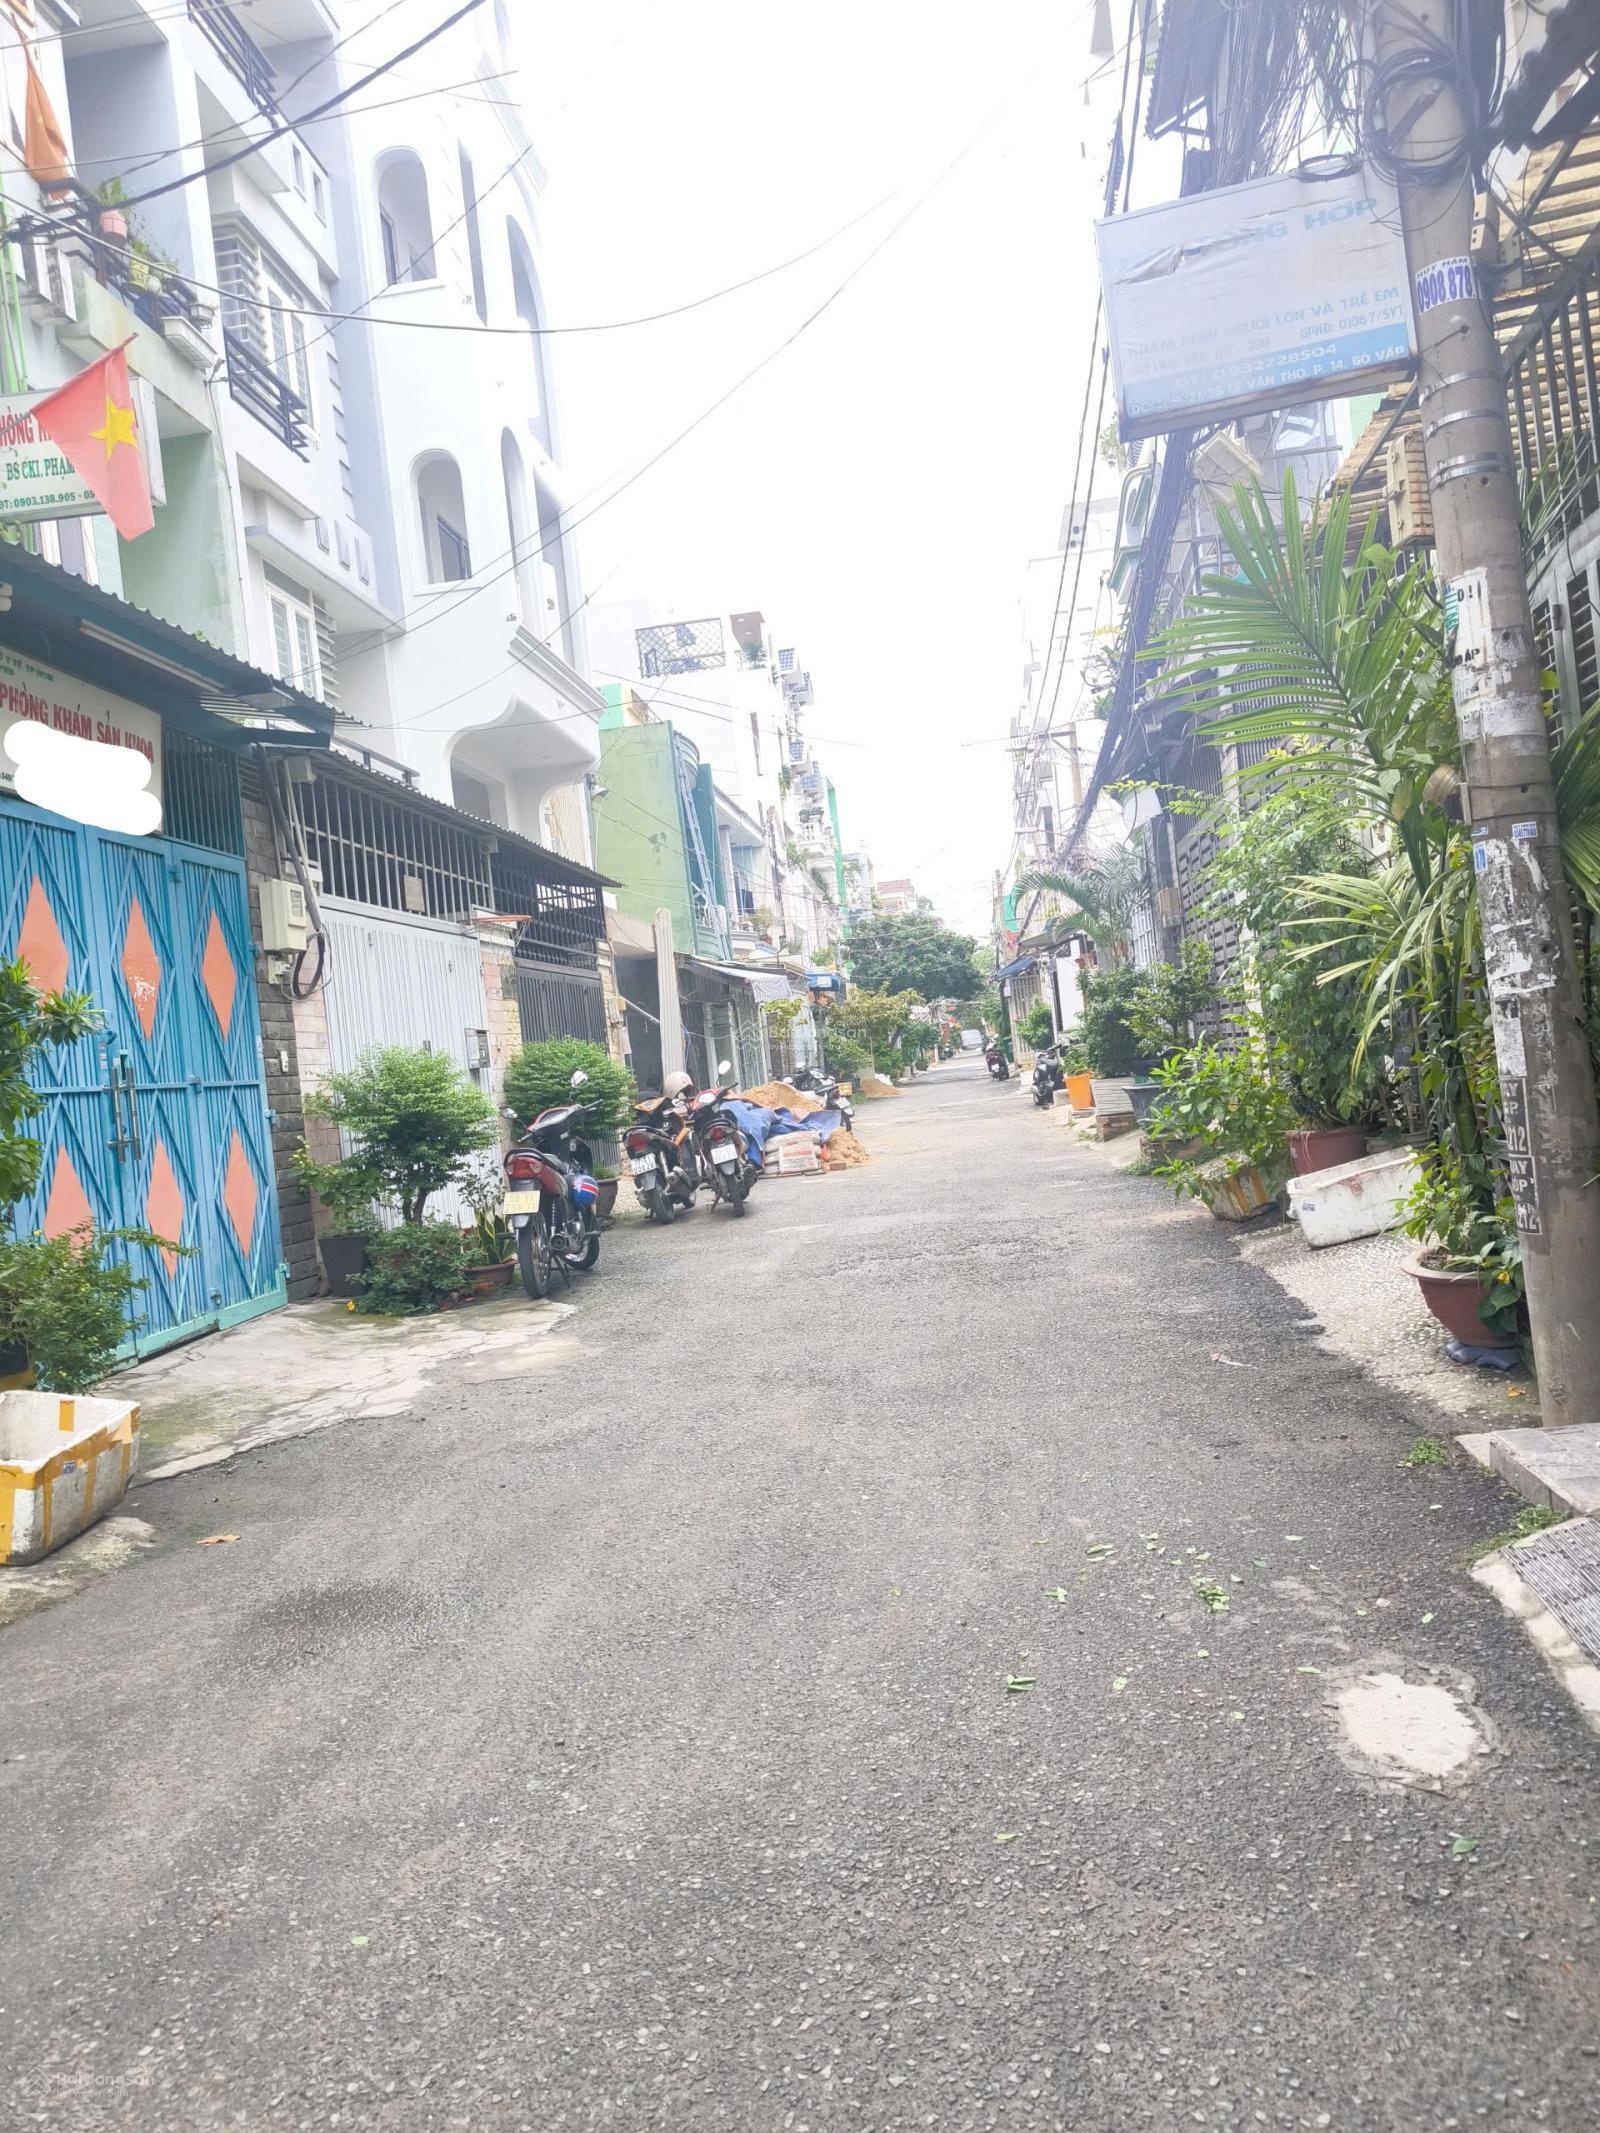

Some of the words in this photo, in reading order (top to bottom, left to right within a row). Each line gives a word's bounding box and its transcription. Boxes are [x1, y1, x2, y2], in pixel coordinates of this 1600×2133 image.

[1373, 284, 1400, 302] EM
[1312, 362, 1326, 376] P.
[7, 462, 20, 480] BS
[0, 682, 49, 726] PHÒNG
[53, 703, 93, 741] KHÁM
[97, 710, 121, 748] SẢN
